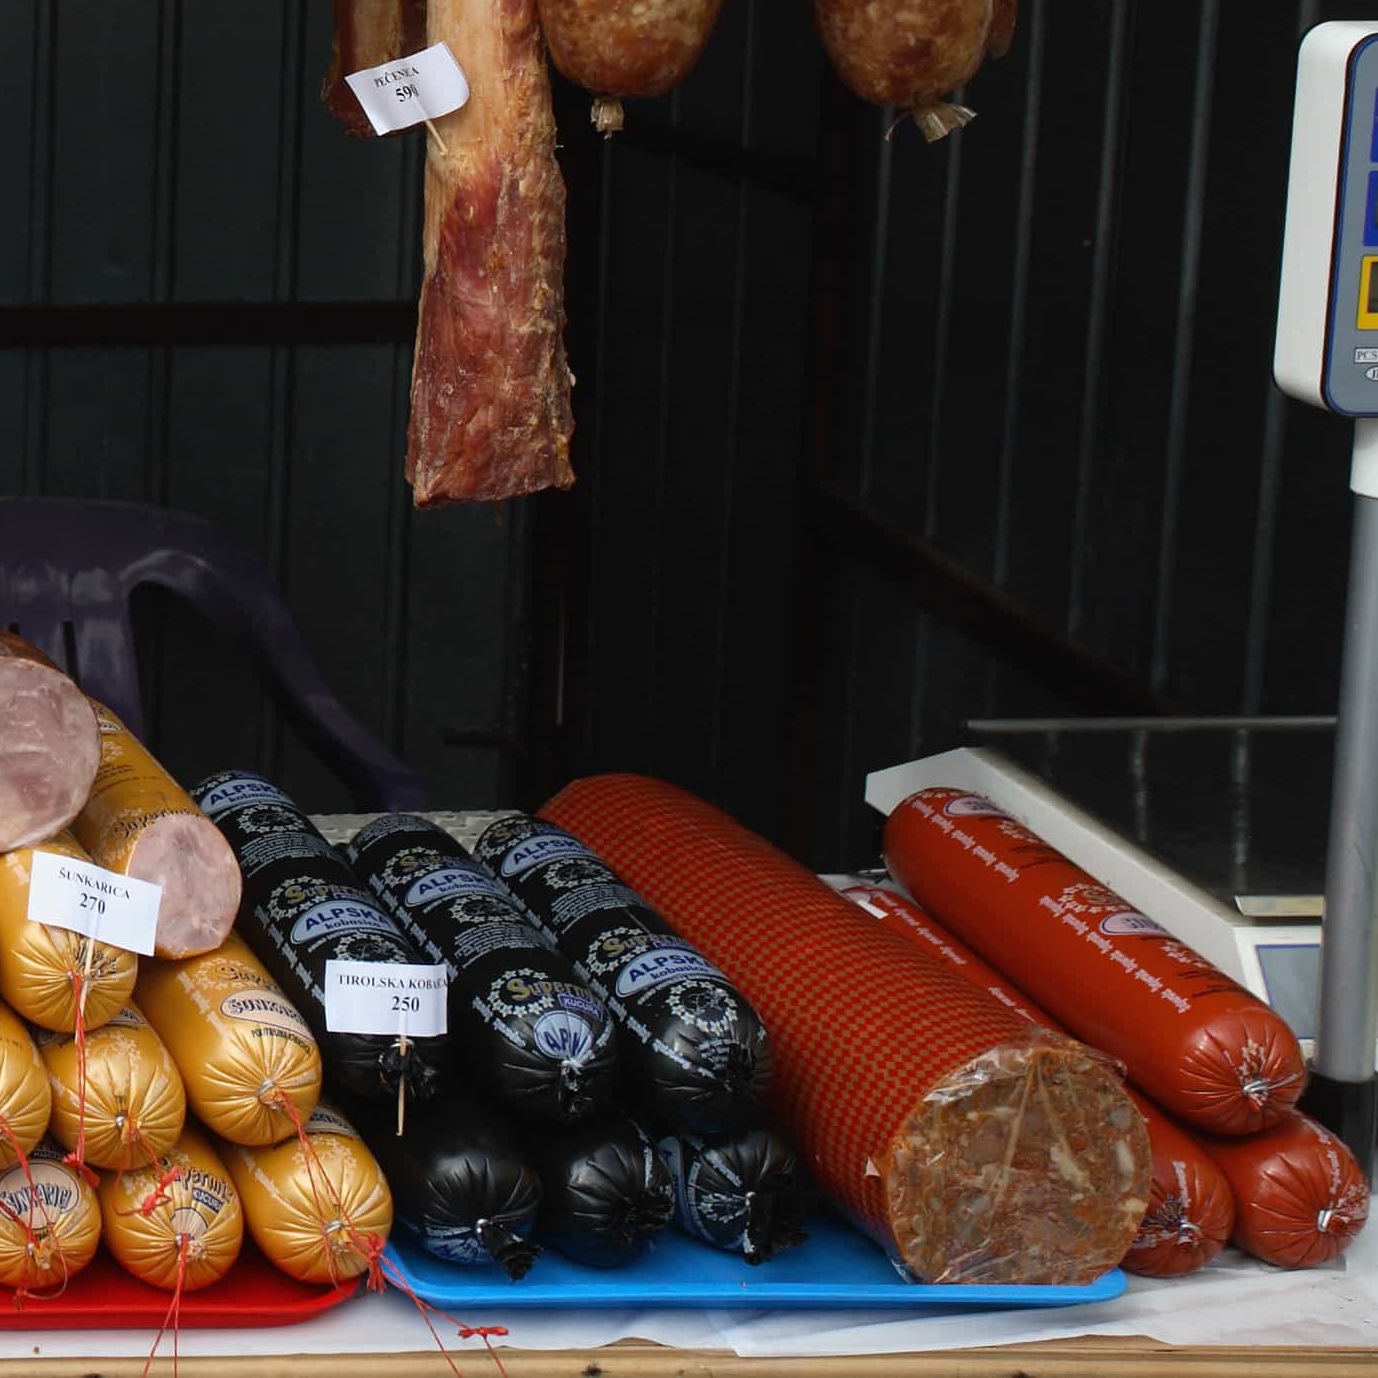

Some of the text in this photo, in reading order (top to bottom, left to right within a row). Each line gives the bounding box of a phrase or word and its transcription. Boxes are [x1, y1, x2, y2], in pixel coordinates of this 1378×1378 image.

[395, 84, 419, 102] 590
[57, 866, 133, 901] ŠUNKARICA
[78, 892, 107, 916] 270
[304, 905, 390, 931] ALPSKA
[338, 974, 406, 989] TIROLSKA
[390, 996, 421, 1012] 250
